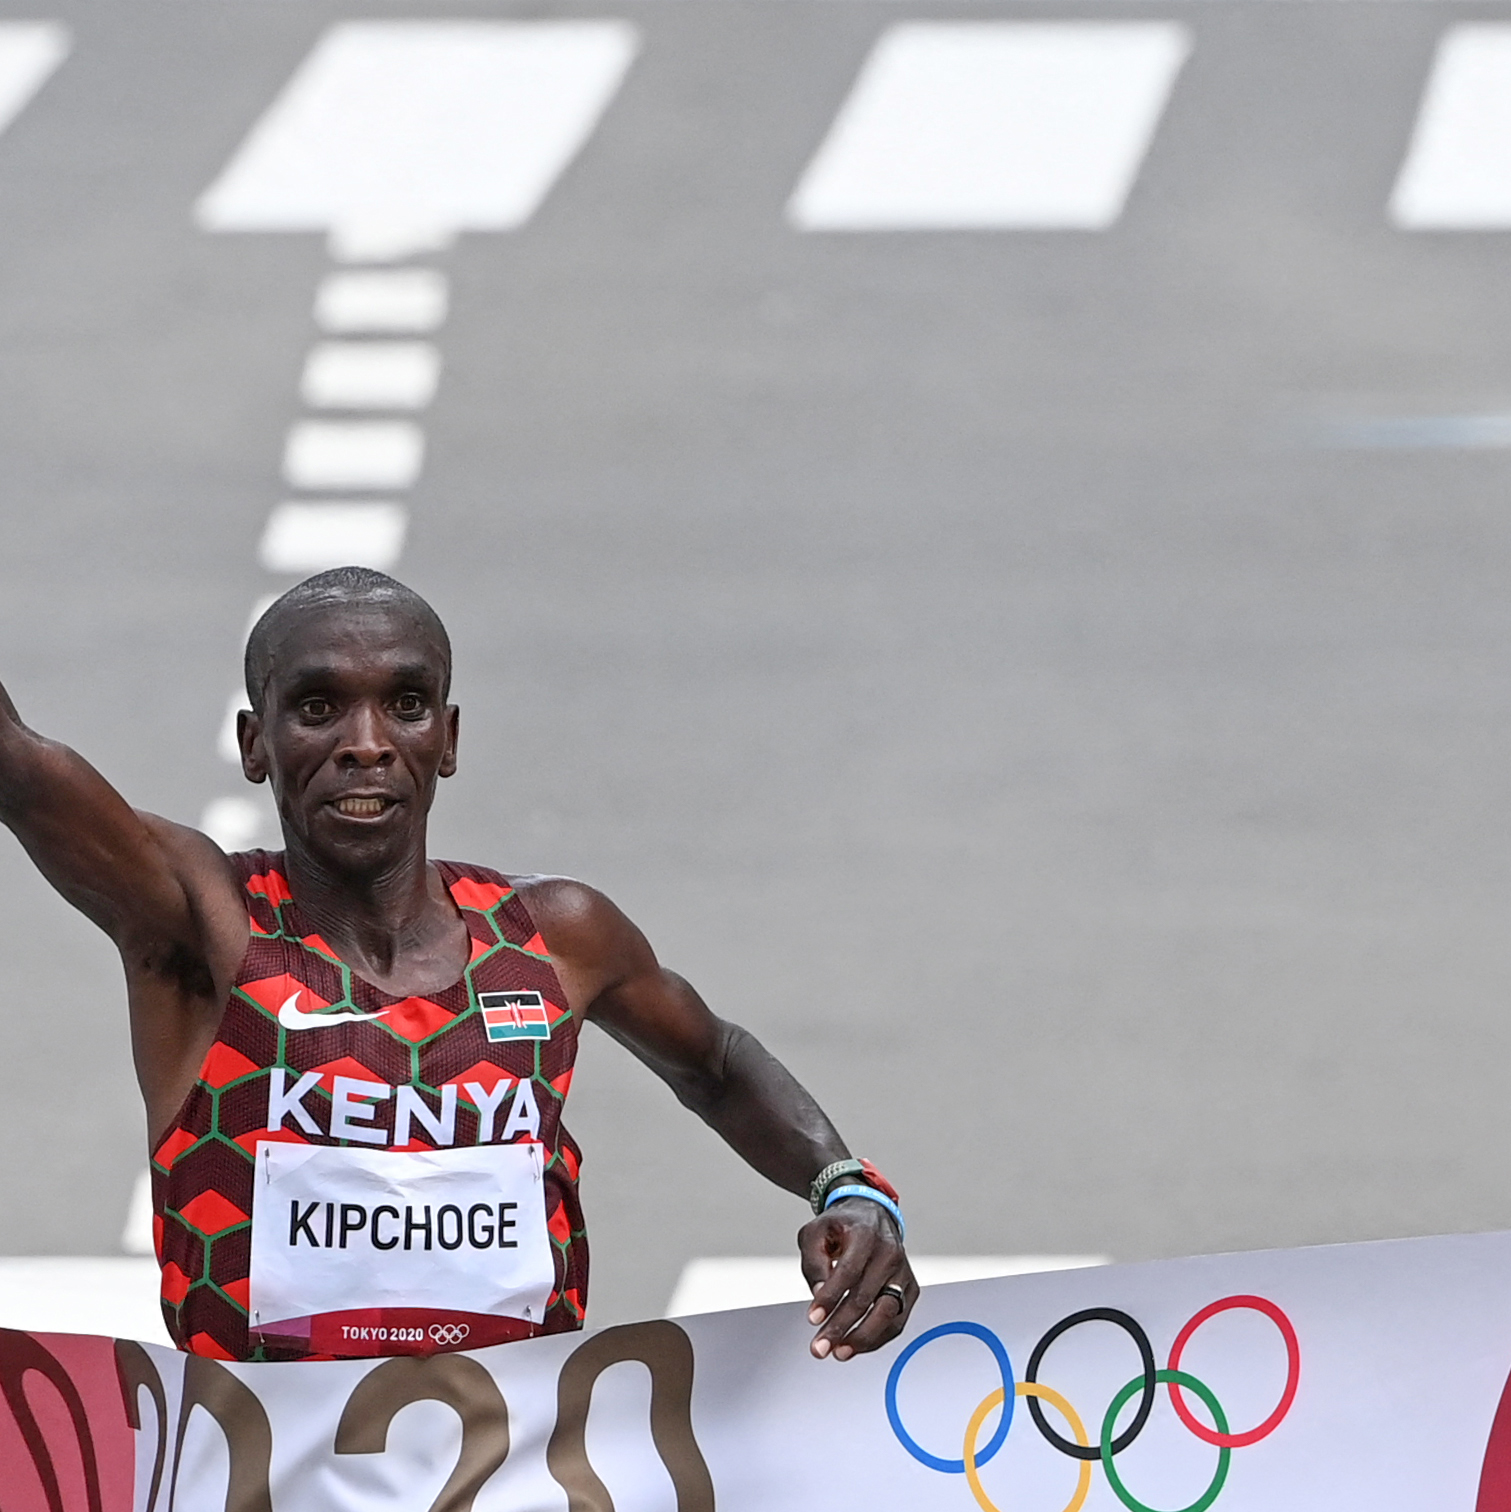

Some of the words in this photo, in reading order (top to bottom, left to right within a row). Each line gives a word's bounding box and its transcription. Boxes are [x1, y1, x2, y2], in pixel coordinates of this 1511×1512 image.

[267, 1067, 541, 1147] KENYA
[288, 1199, 519, 1252] KIPCHOGE
[341, 1325, 388, 1341] TOKYO
[389, 1327, 424, 1341] 2020
